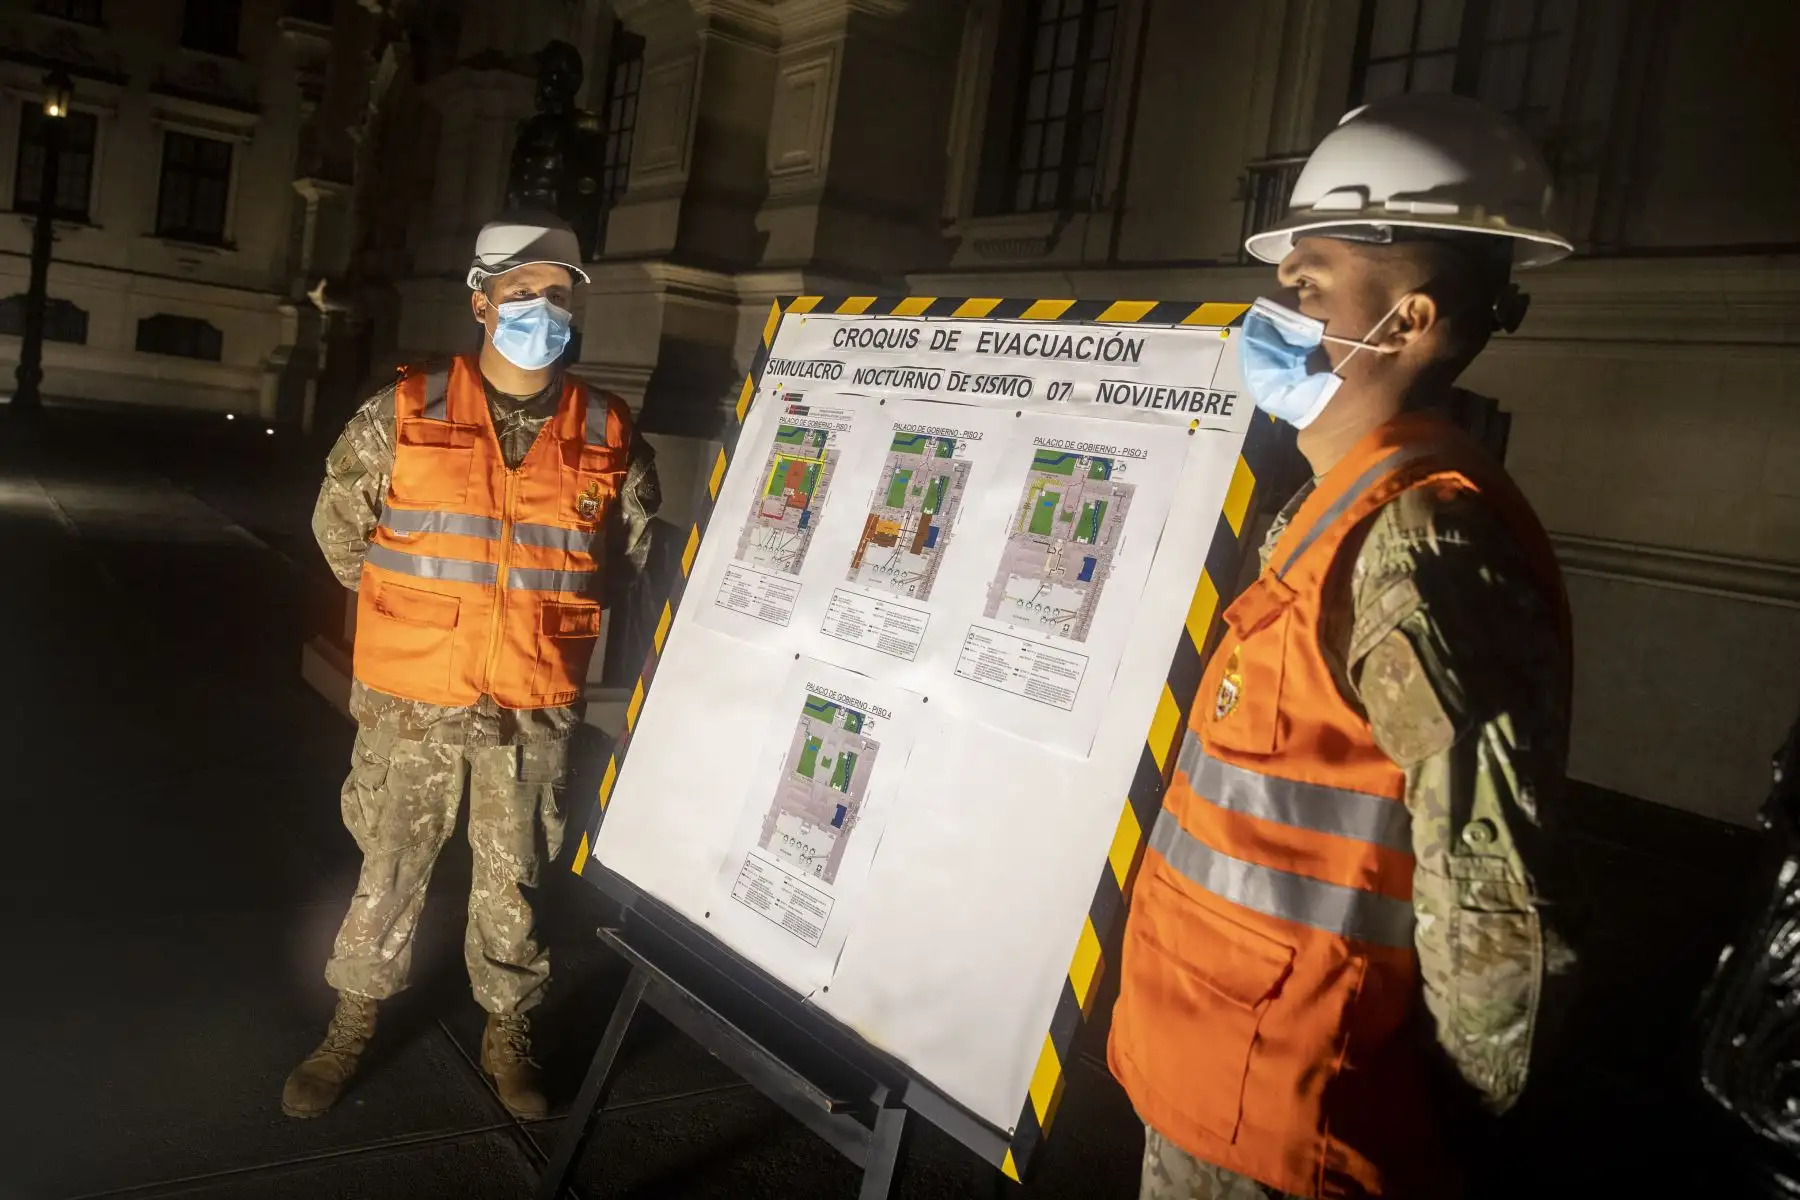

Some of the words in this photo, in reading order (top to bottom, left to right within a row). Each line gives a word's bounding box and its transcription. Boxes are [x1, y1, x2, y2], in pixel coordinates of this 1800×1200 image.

[832, 327, 921, 350] CROQUIS
[929, 329, 962, 352] DE
[975, 330, 1145, 363] EVACUACIÓN
[766, 359, 843, 381] SIMULACRO
[852, 367, 941, 391] NOCTURNO
[946, 373, 970, 393] DE
[971, 375, 1033, 399] SISMO
[1046, 382, 1073, 401] 07
[1095, 382, 1237, 417] NOVIEMBRE
[779, 416, 799, 426] PALACIO
[893, 423, 917, 432] PALACIO
[926, 426, 958, 437] GOBIERNO
[963, 430, 979, 439] PISO
[1033, 436, 1063, 447] PALACIO
[1065, 441, 1075, 449] DE
[1076, 442, 1117, 454] GOBIERNO
[1122, 447, 1141, 457] PISO
[1142, 450, 1148, 458] 3
[806, 682, 828, 695] PALACIO
[829, 689, 837, 699] DE
[837, 693, 867, 709] GOBIERNO
[872, 705, 887, 717] PISO
[887, 711, 892, 719] 4
